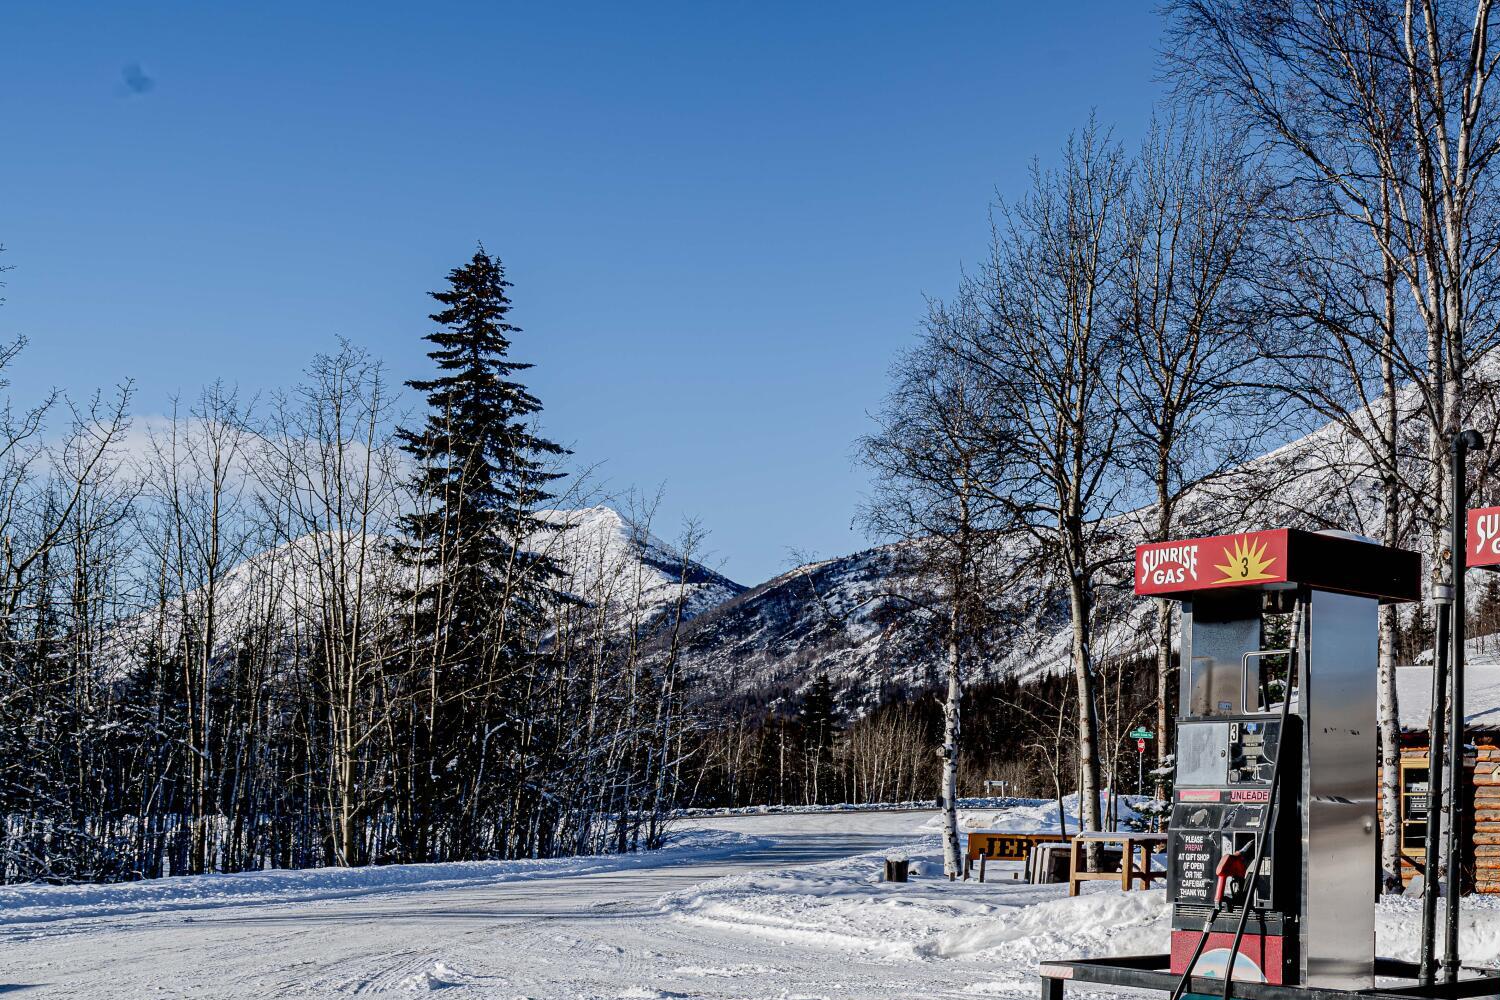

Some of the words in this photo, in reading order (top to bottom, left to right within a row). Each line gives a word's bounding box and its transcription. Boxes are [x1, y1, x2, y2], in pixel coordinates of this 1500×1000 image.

[1142, 545, 1198, 584] SUNRISE
[1240, 557, 1249, 578] 3
[1153, 567, 1185, 585] GAS
[1231, 724, 1237, 741] 3
[1231, 791, 1268, 800] UNLEADE
[1185, 835, 1204, 844] PLEASE
[1185, 844, 1204, 852] PREPAY
[1178, 853, 1186, 861] AT
[1186, 853, 1196, 861] GIFT
[1197, 853, 1210, 861] SHOP
[1193, 871, 1202, 879] THE
[1180, 888, 1197, 896] THANK
[1197, 889, 1207, 897] YOU
